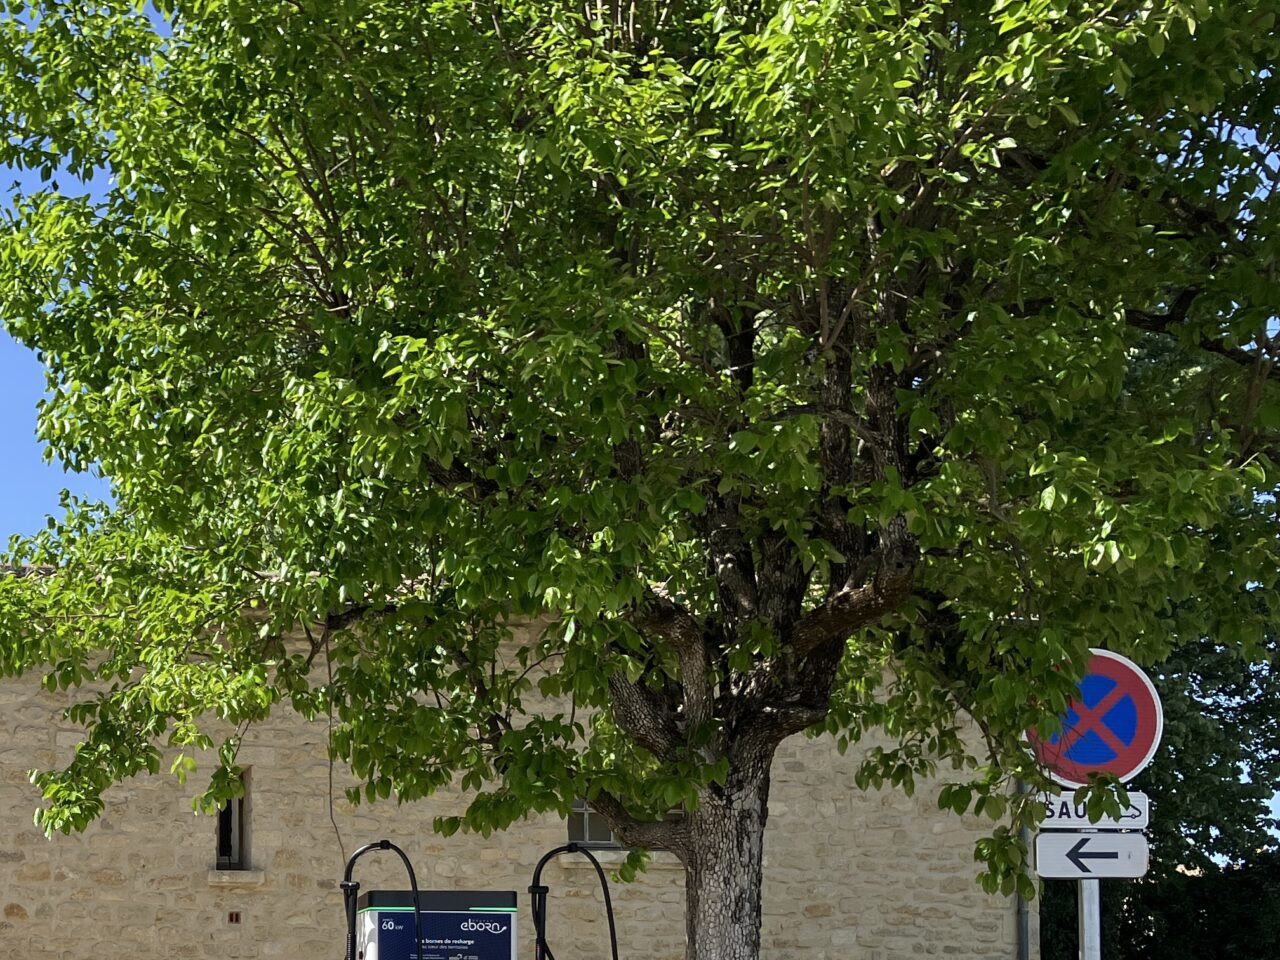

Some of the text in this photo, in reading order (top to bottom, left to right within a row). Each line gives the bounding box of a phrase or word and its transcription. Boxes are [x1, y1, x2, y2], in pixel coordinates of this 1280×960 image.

[1045, 801, 1087, 819] SAU
[382, 921, 395, 930] 60
[460, 918, 507, 934] eborn
